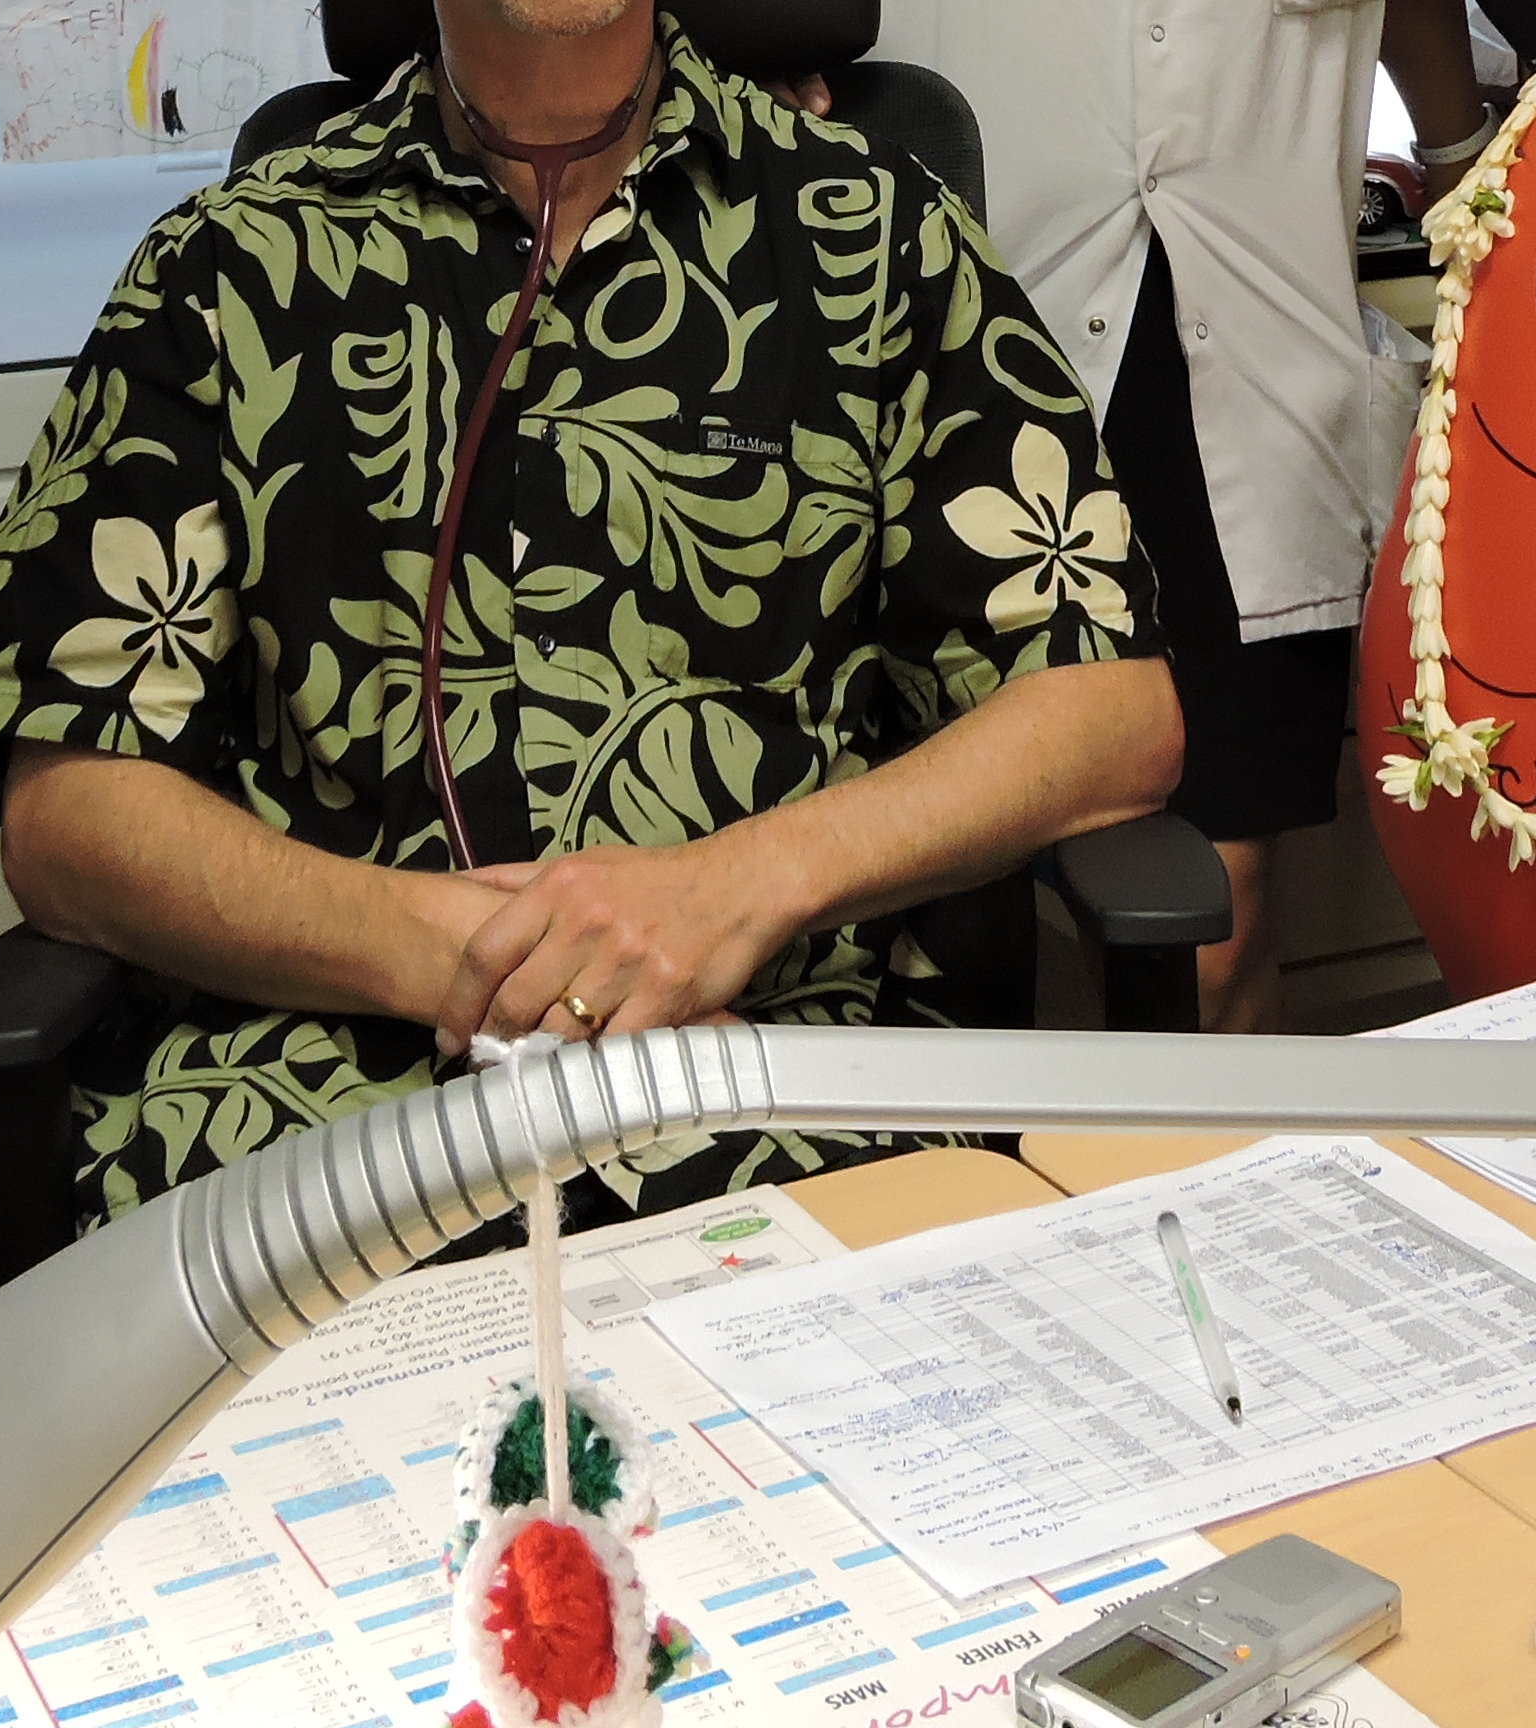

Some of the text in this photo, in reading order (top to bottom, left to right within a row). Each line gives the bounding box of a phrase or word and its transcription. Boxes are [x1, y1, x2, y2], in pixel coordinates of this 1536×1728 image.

[728, 433, 745, 448] Te
[501, 1287, 528, 1298] Par
[406, 1300, 425, 1311] BP
[512, 1299, 526, 1310] ar
[384, 1326, 470, 1356] montagne
[459, 1325, 530, 1349] magasin
[322, 1359, 455, 1401] commander
[354, 1362, 394, 1380] rond
[304, 1372, 349, 1392] point
[954, 1629, 1044, 1666] FÉVRIER
[824, 1679, 888, 1711] MARS
